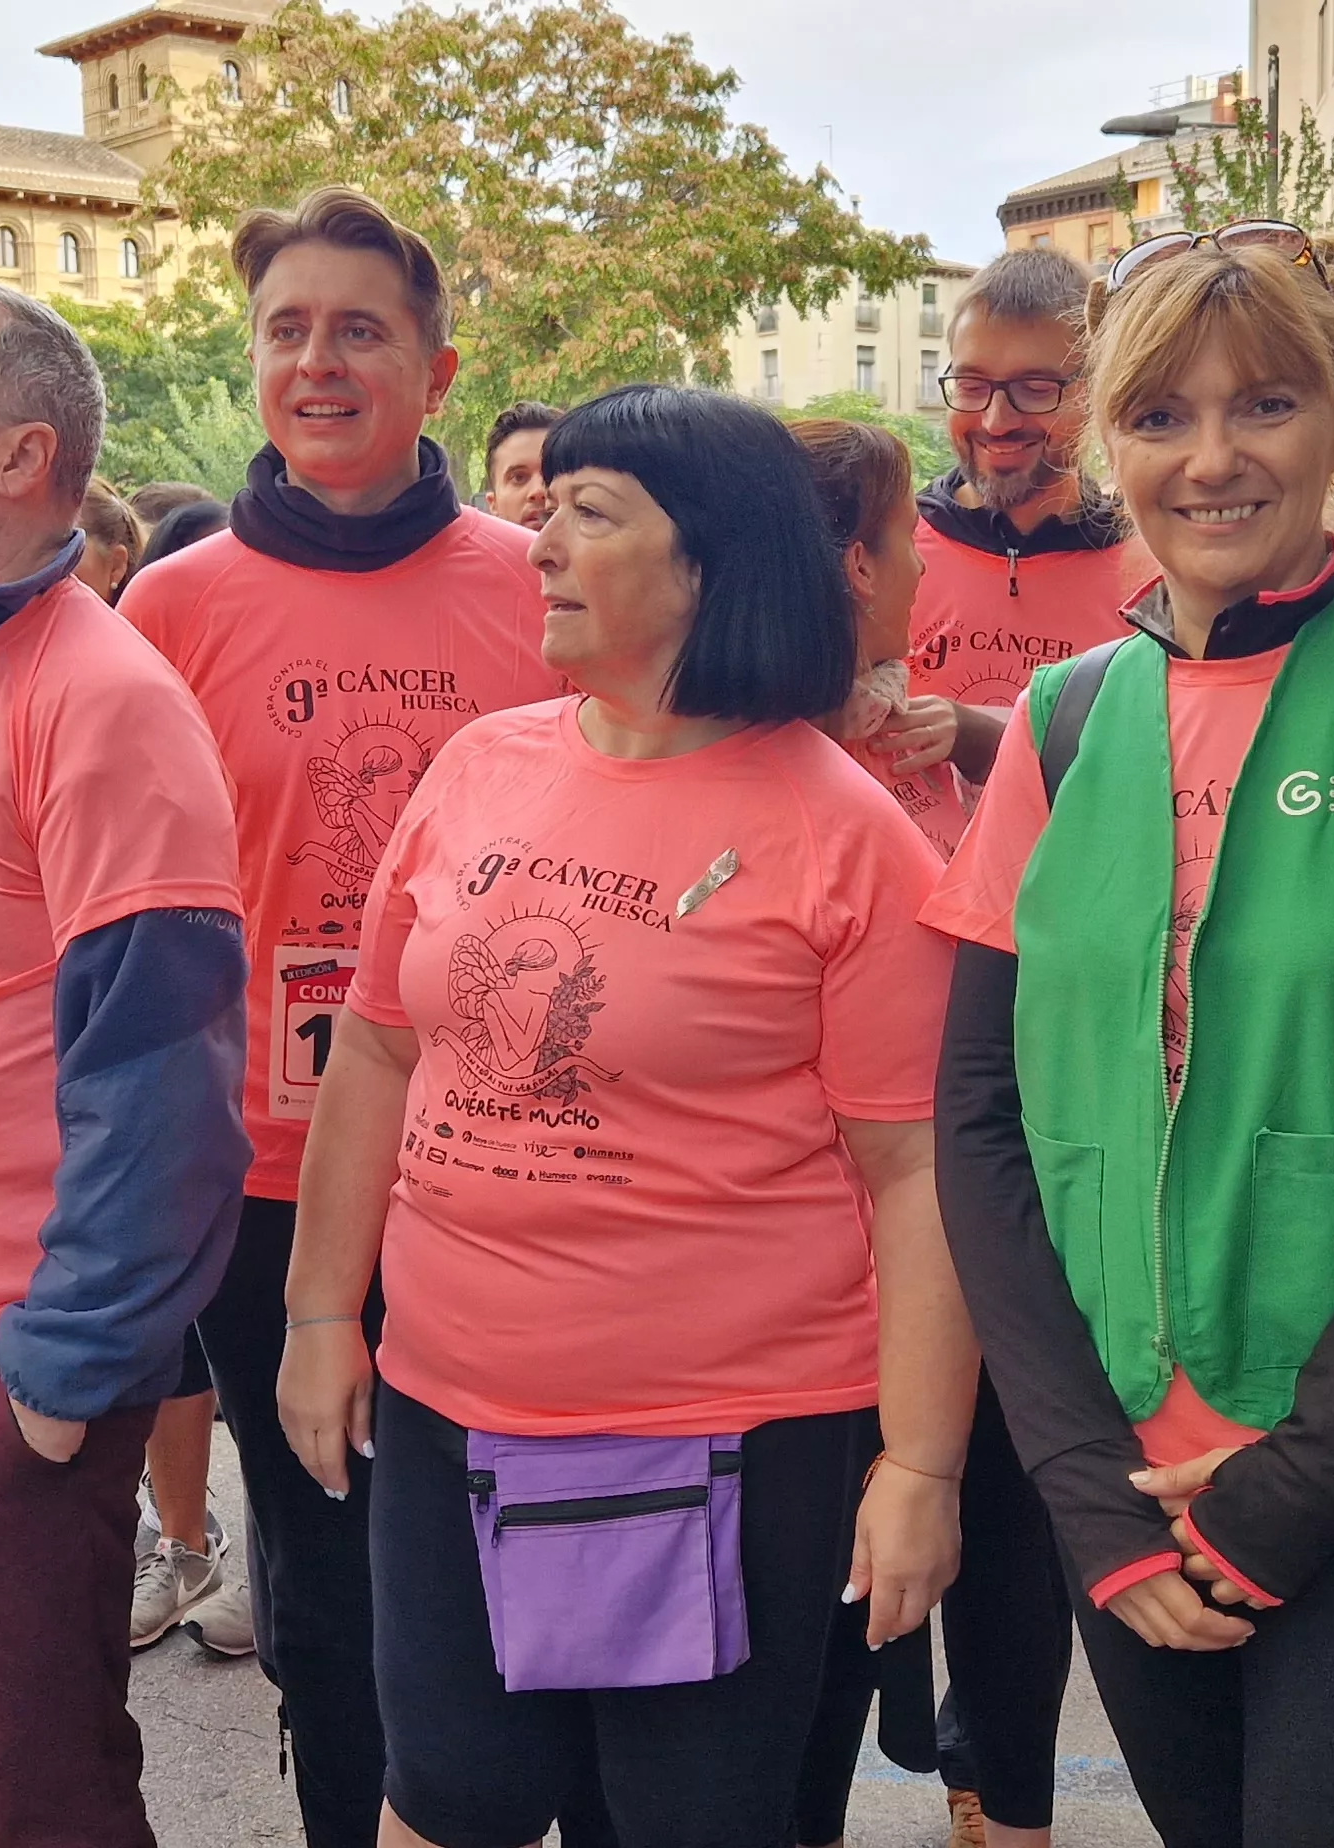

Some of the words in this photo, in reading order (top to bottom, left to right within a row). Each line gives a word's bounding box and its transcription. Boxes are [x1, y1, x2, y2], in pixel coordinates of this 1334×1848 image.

[316, 659, 329, 672] EL
[923, 634, 962, 671] 9ª
[970, 628, 1074, 659] CÁNCER
[270, 658, 312, 691] CONTRA
[285, 678, 328, 723] 9ª
[336, 664, 457, 694] CÁNCER
[401, 694, 481, 714] HUESCA
[266, 694, 303, 739] CARRERA
[467, 853, 522, 896] 9ª
[528, 857, 659, 905] CÁNCER
[320, 886, 368, 909] QUIÉR
[581, 893, 672, 933] HUESCA
[299, 984, 345, 1001] CON
[295, 1013, 333, 1077] 1
[529, 1107, 600, 1130] MUCHO
